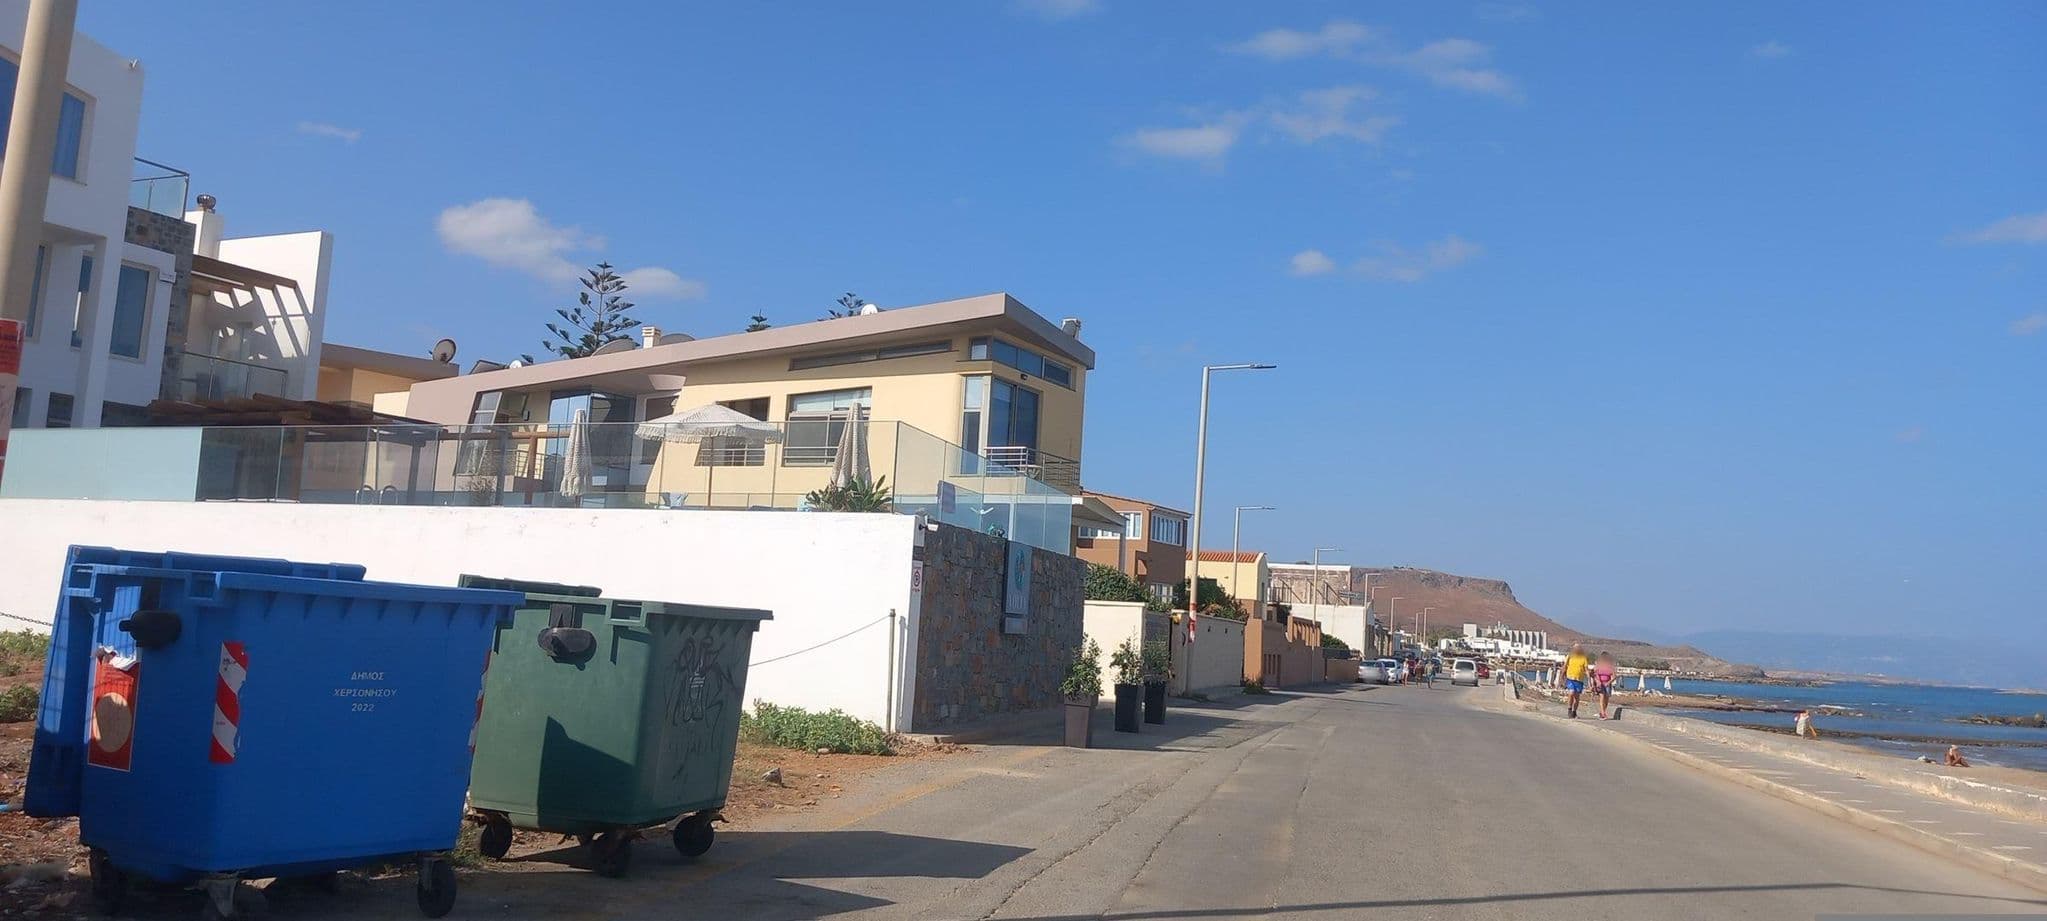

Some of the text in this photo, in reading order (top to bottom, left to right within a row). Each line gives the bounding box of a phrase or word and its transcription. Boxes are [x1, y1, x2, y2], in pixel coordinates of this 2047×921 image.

[350, 671, 385, 681] ΔΗΜΟΣ
[333, 688, 398, 697] ΧΕΡΣΟΝΗΣΟΥ
[351, 703, 376, 712] 2022
